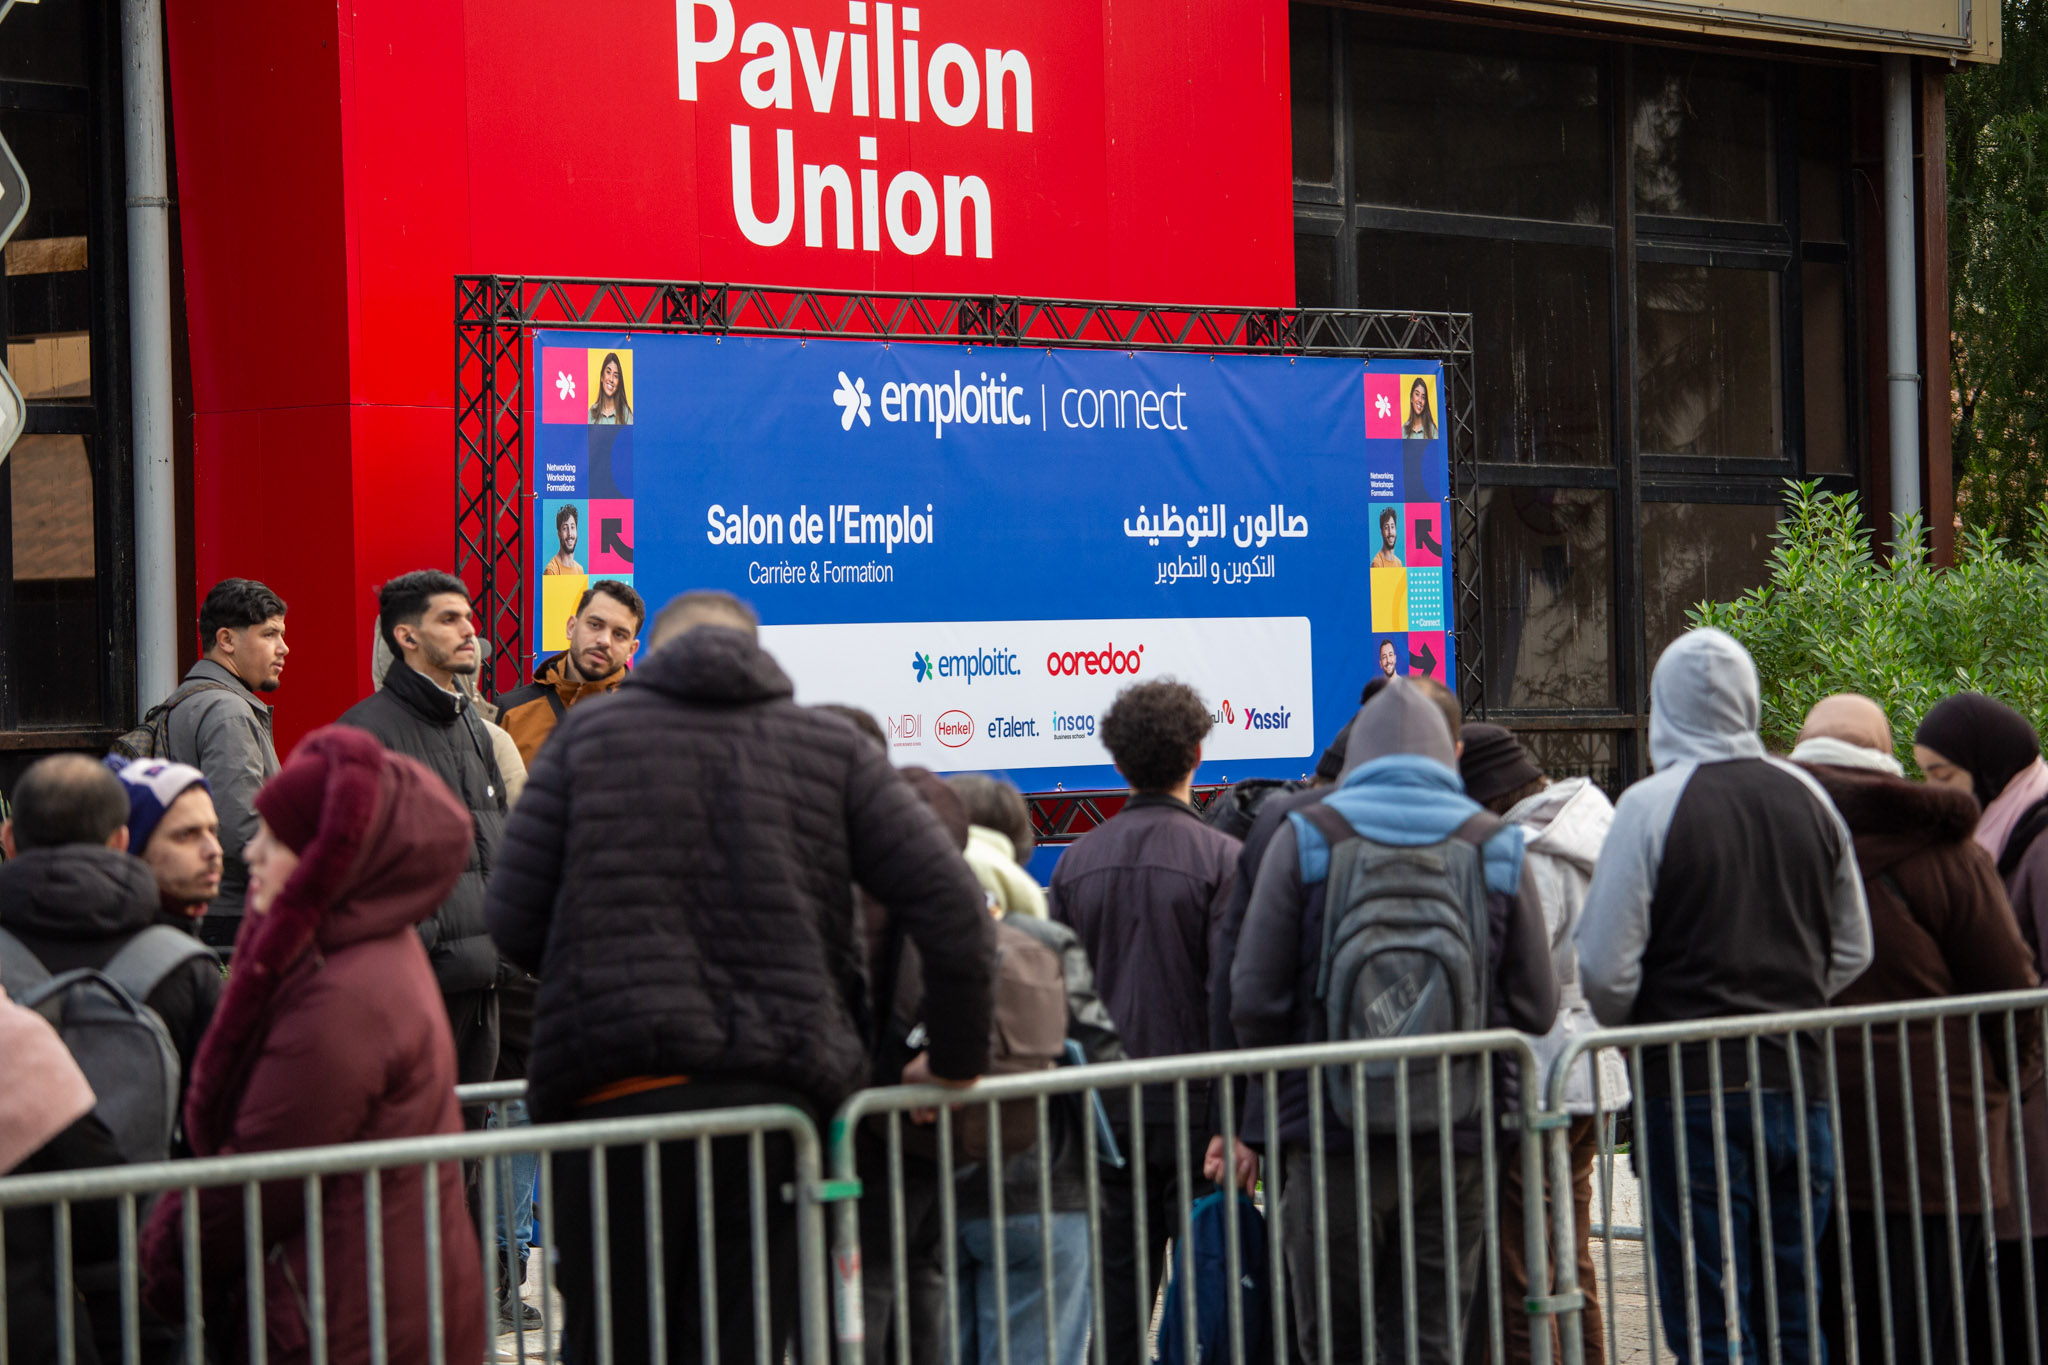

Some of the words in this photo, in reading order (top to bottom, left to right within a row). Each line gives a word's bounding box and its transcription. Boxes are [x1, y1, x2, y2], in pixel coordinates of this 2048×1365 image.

[676, 0, 1033, 133] Pavilion
[731, 124, 993, 259] Union
[881, 370, 1031, 439] emploitic.
[1061, 384, 1188, 430] connect
[546, 463, 576, 473] Networking
[546, 474, 576, 483] Workshops
[1370, 472, 1394, 480] Networking
[546, 483, 576, 492] Formations
[1370, 481, 1394, 489] Workshops
[706, 504, 783, 545] Salon
[789, 504, 824, 545] de
[1123, 503, 1226, 548] التوظيف
[1233, 504, 1309, 548] صالون
[748, 560, 806, 584] Carrière
[809, 560, 820, 584] &
[823, 560, 894, 583] Formation
[1154, 554, 1207, 585] التطوير
[1210, 561, 1220, 585] و
[1223, 554, 1275, 585] التكوين
[938, 647, 1021, 685] emploitic.
[1047, 642, 1144, 676] ooredoo
[888, 714, 922, 739] MDI
[938, 721, 971, 736] Henkel
[988, 715, 1040, 738] eTalent.
[1053, 711, 1095, 736] insag
[1244, 705, 1291, 730] Yassir
[1365, 973, 1420, 1037] NIKE
